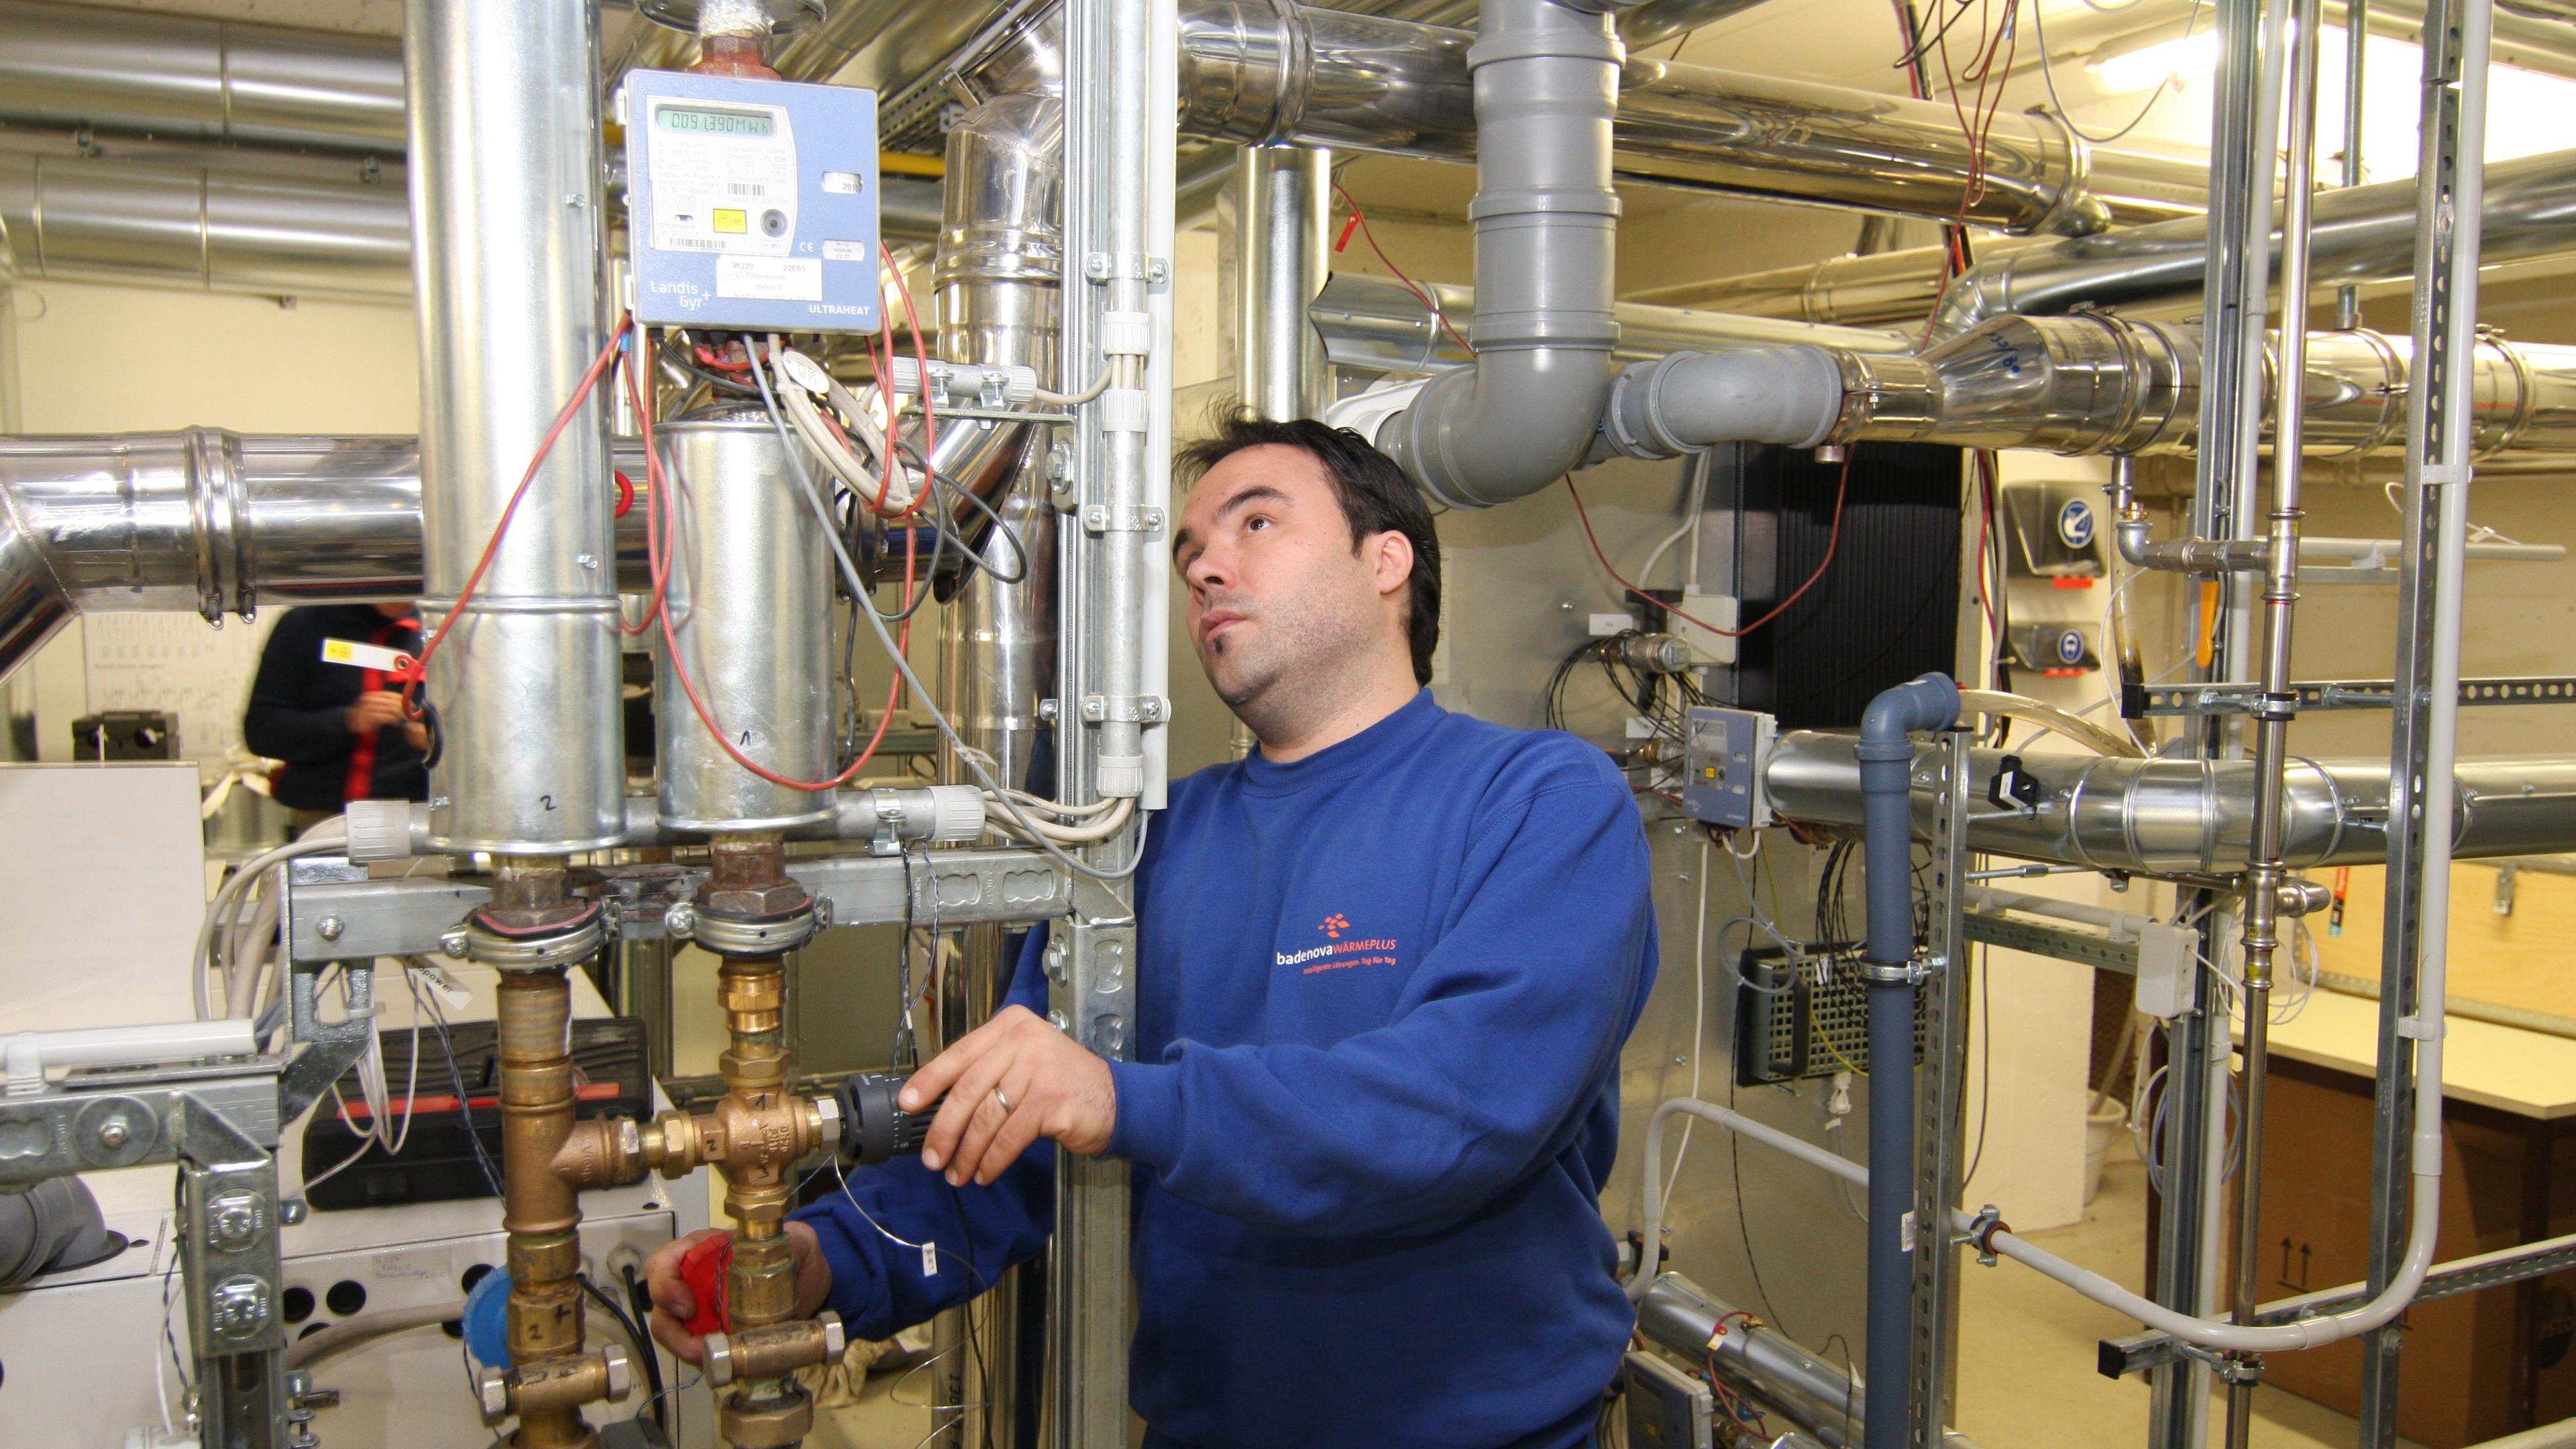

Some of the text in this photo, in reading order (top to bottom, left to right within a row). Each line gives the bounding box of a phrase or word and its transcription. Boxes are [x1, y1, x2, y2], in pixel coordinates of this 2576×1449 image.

[650, 280, 699, 294] Landis
[809, 305, 870, 316] ULTRAHEAT
[540, 794, 557, 812] 2
[1384, 956, 1397, 966] Tag
